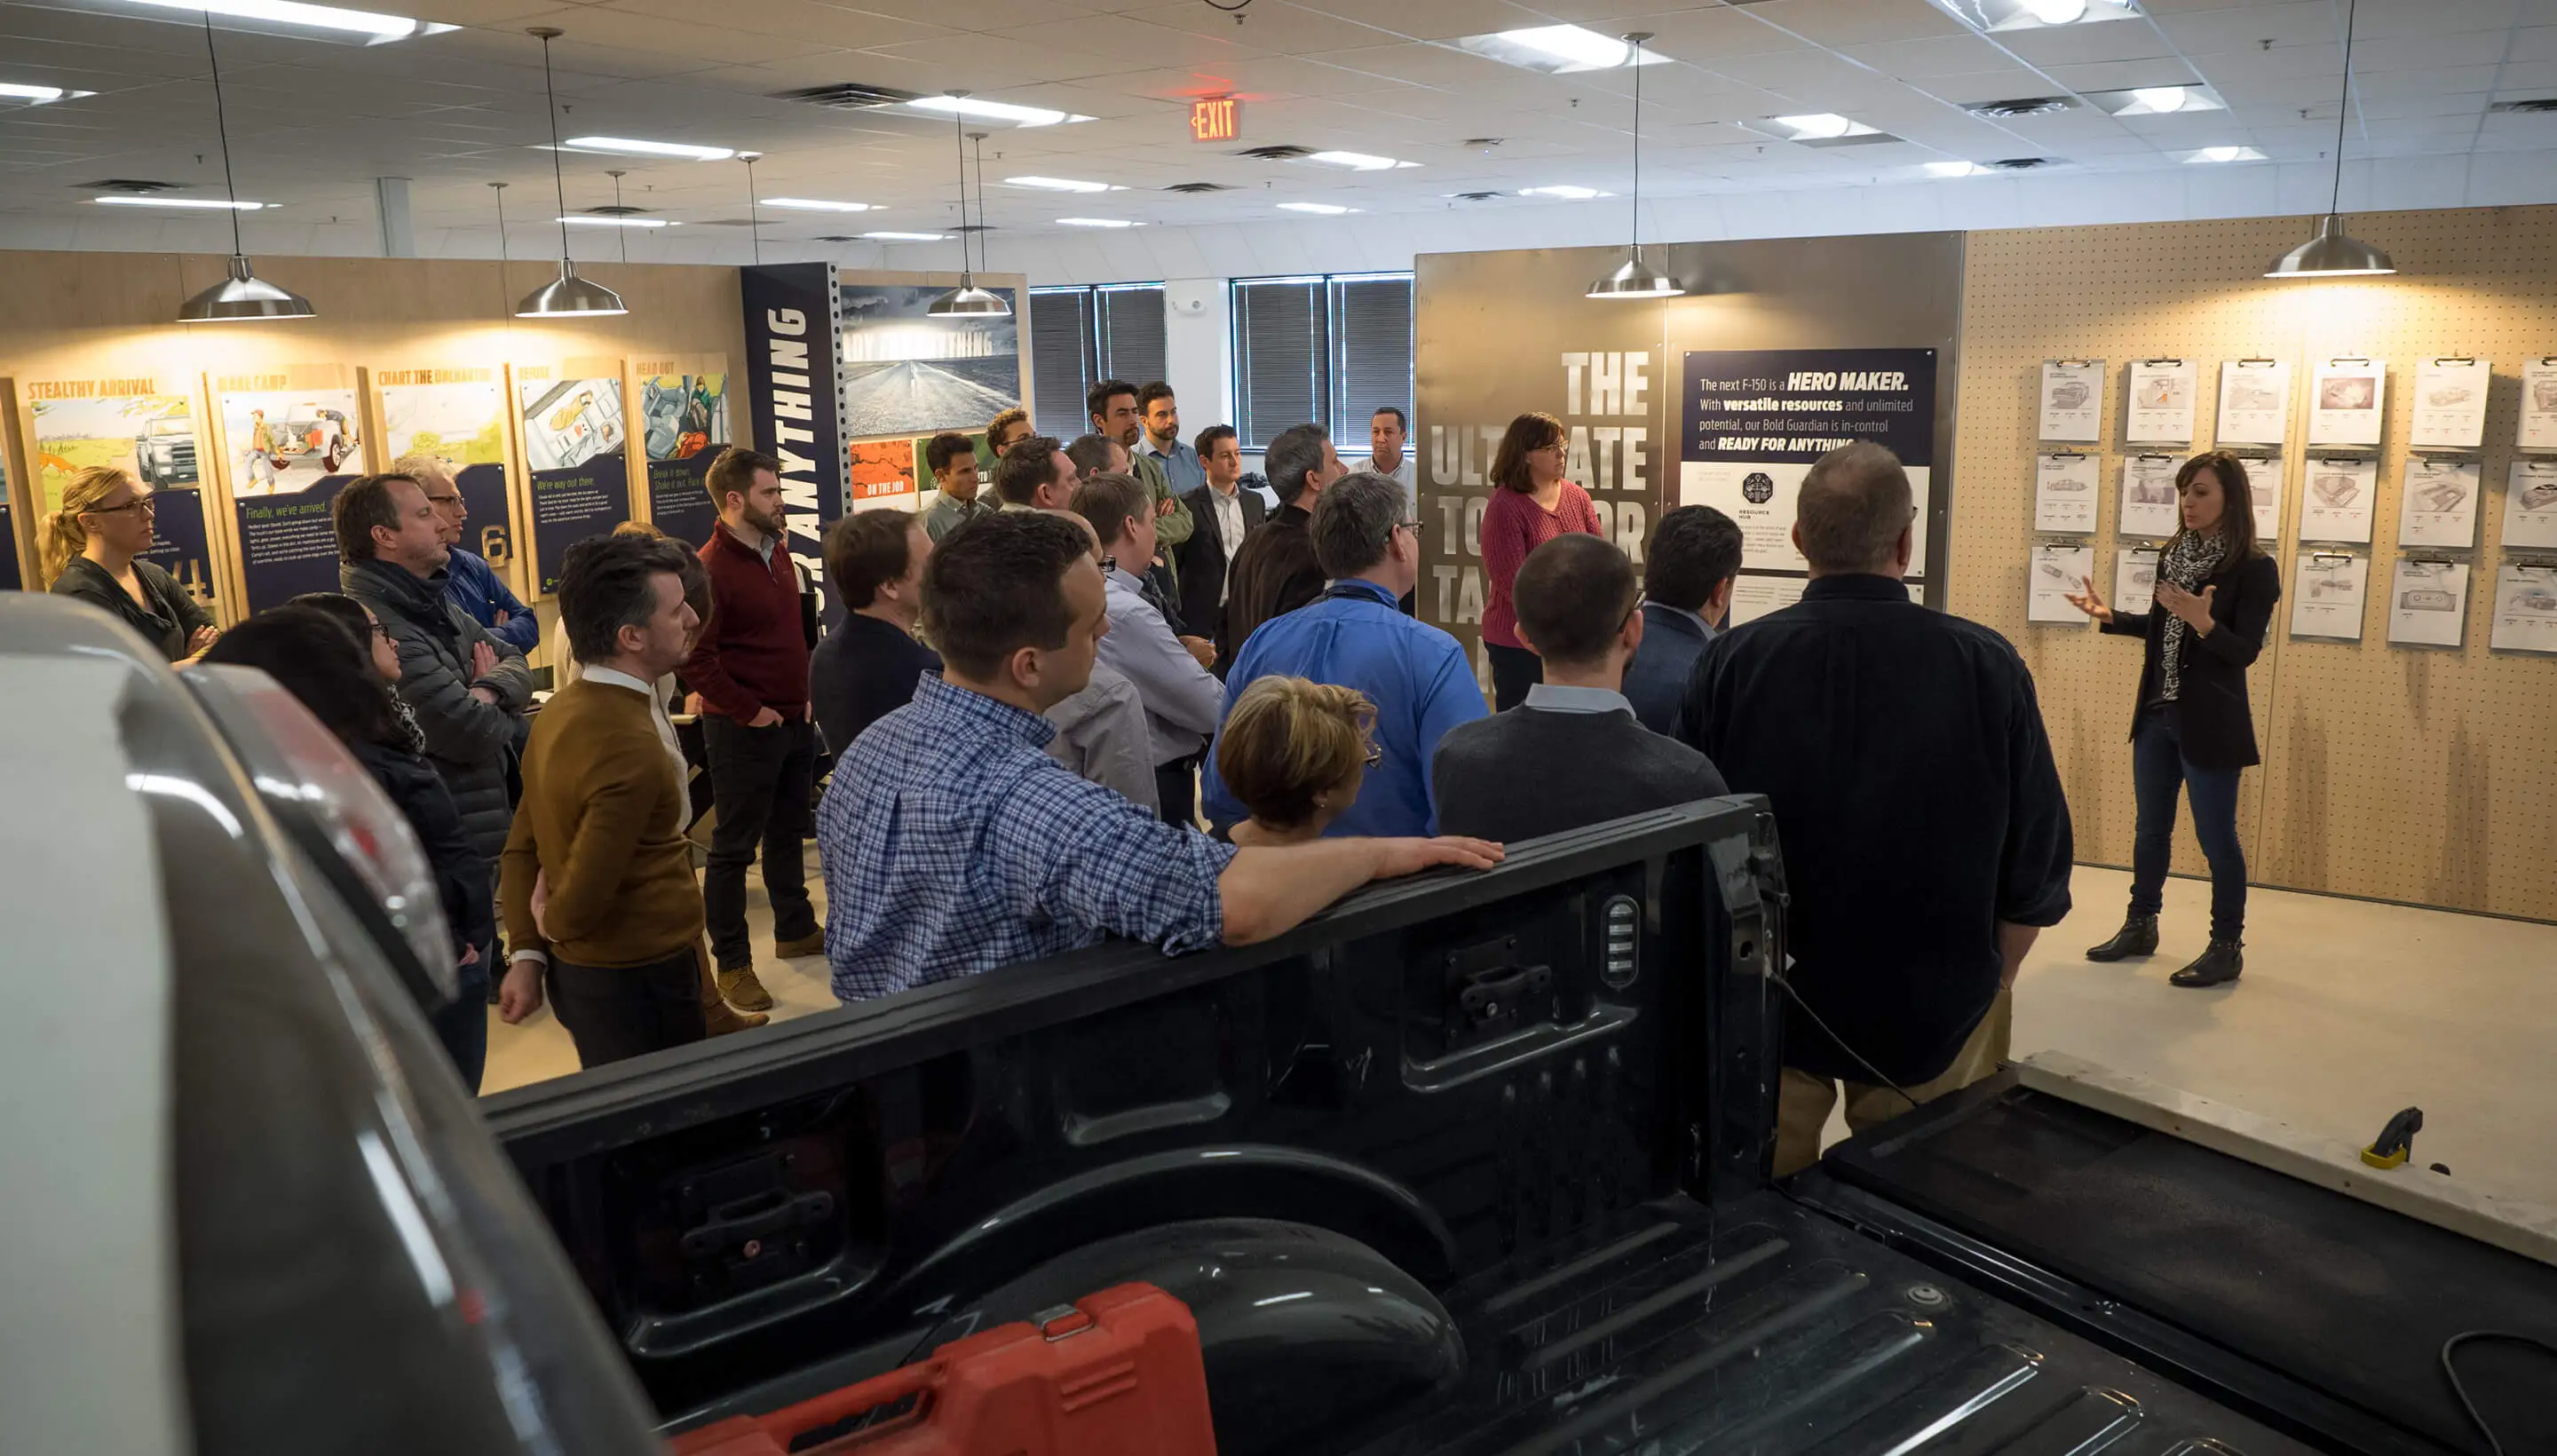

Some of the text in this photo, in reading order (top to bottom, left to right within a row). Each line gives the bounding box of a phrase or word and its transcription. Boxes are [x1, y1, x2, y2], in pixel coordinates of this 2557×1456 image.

[1196, 99, 1233, 138] EXIT
[254, 374, 287, 391] CAMP
[378, 369, 411, 386] CHART
[414, 369, 433, 385] THE
[1561, 352, 1649, 415] THE
[1700, 372, 1909, 392] The next F-150 is a HERO MAKER.
[28, 378, 155, 400] STEALTHY ARRIVAL
[1699, 398, 1913, 412] With versatile resources and unlimited
[768, 308, 822, 542] ANYTHING
[1699, 418, 1889, 433] potential, our Bold Guardian is in-control
[1698, 438, 1716, 450] and
[1718, 437, 1760, 451] READY
[1761, 437, 1785, 451] FOR
[1431, 424, 1647, 490] ULTATE
[867, 480, 905, 496] ON THE JOB
[246, 500, 327, 519] Finally, we've arrived.
[481, 525, 507, 567] 6
